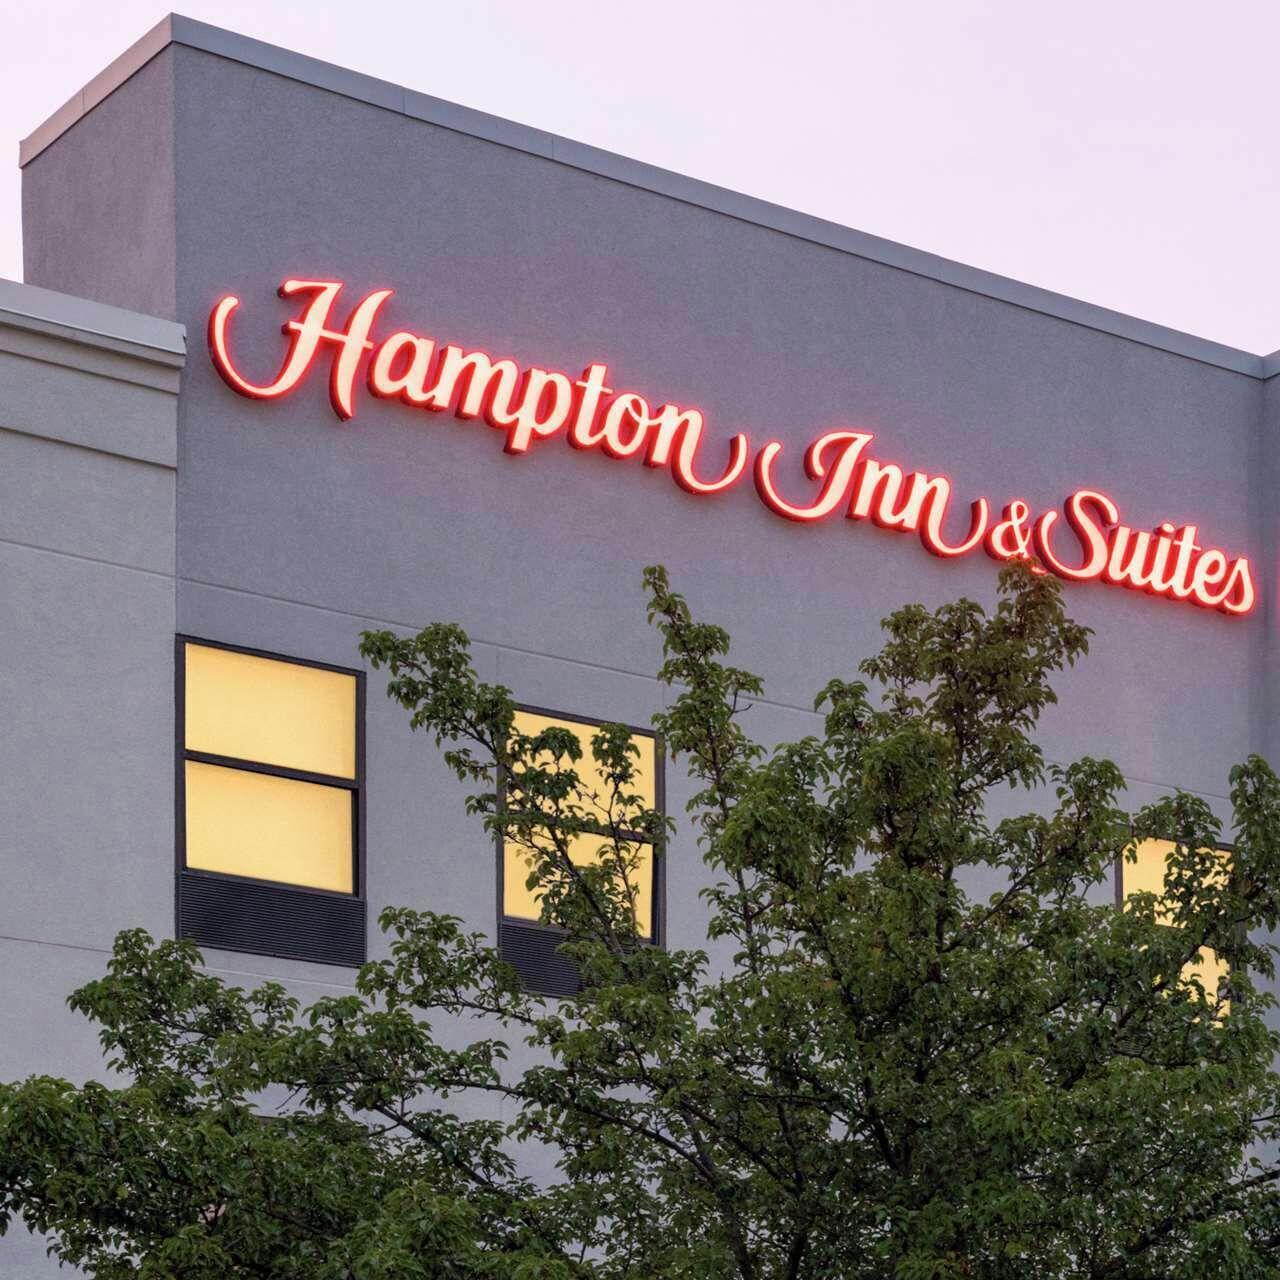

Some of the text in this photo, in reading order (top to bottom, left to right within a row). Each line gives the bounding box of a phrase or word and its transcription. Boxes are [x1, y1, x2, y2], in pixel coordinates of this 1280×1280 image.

[207, 277, 1256, 616] Hampton Inn & Suites
